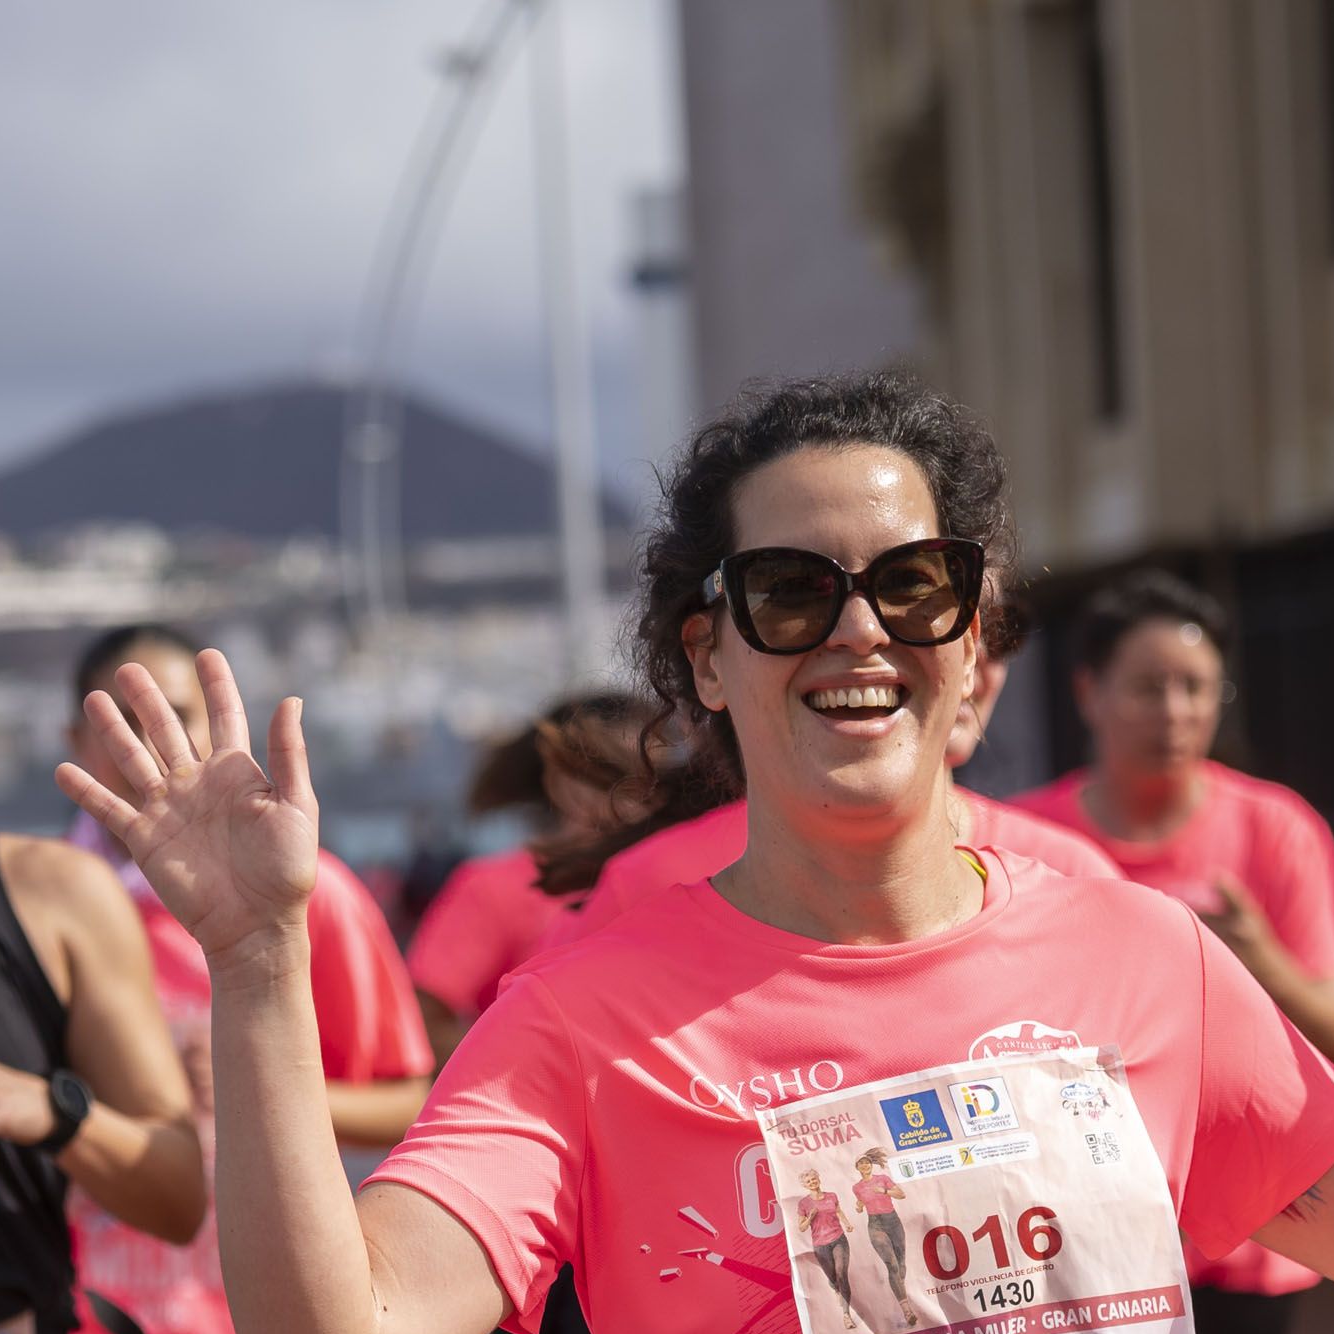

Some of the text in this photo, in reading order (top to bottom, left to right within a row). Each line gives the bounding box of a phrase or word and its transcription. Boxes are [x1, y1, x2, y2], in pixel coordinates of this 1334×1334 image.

[689, 1060, 844, 1112] OYSHO
[779, 1112, 856, 1140] TU DORSAL
[788, 1123, 862, 1156] SUMA
[898, 1132, 948, 1147] Gran Canaria
[899, 1126, 940, 1140] Cabildo de
[922, 1206, 1063, 1281] 016
[926, 1281, 969, 1295] TELÉFONO
[970, 1270, 1014, 1287] VIOLENCIA
[1015, 1268, 1026, 1277] DE
[973, 1279, 1035, 1313] 1430
[1042, 1307, 1092, 1329] GRAN
[1097, 1295, 1171, 1321] CANARIA
